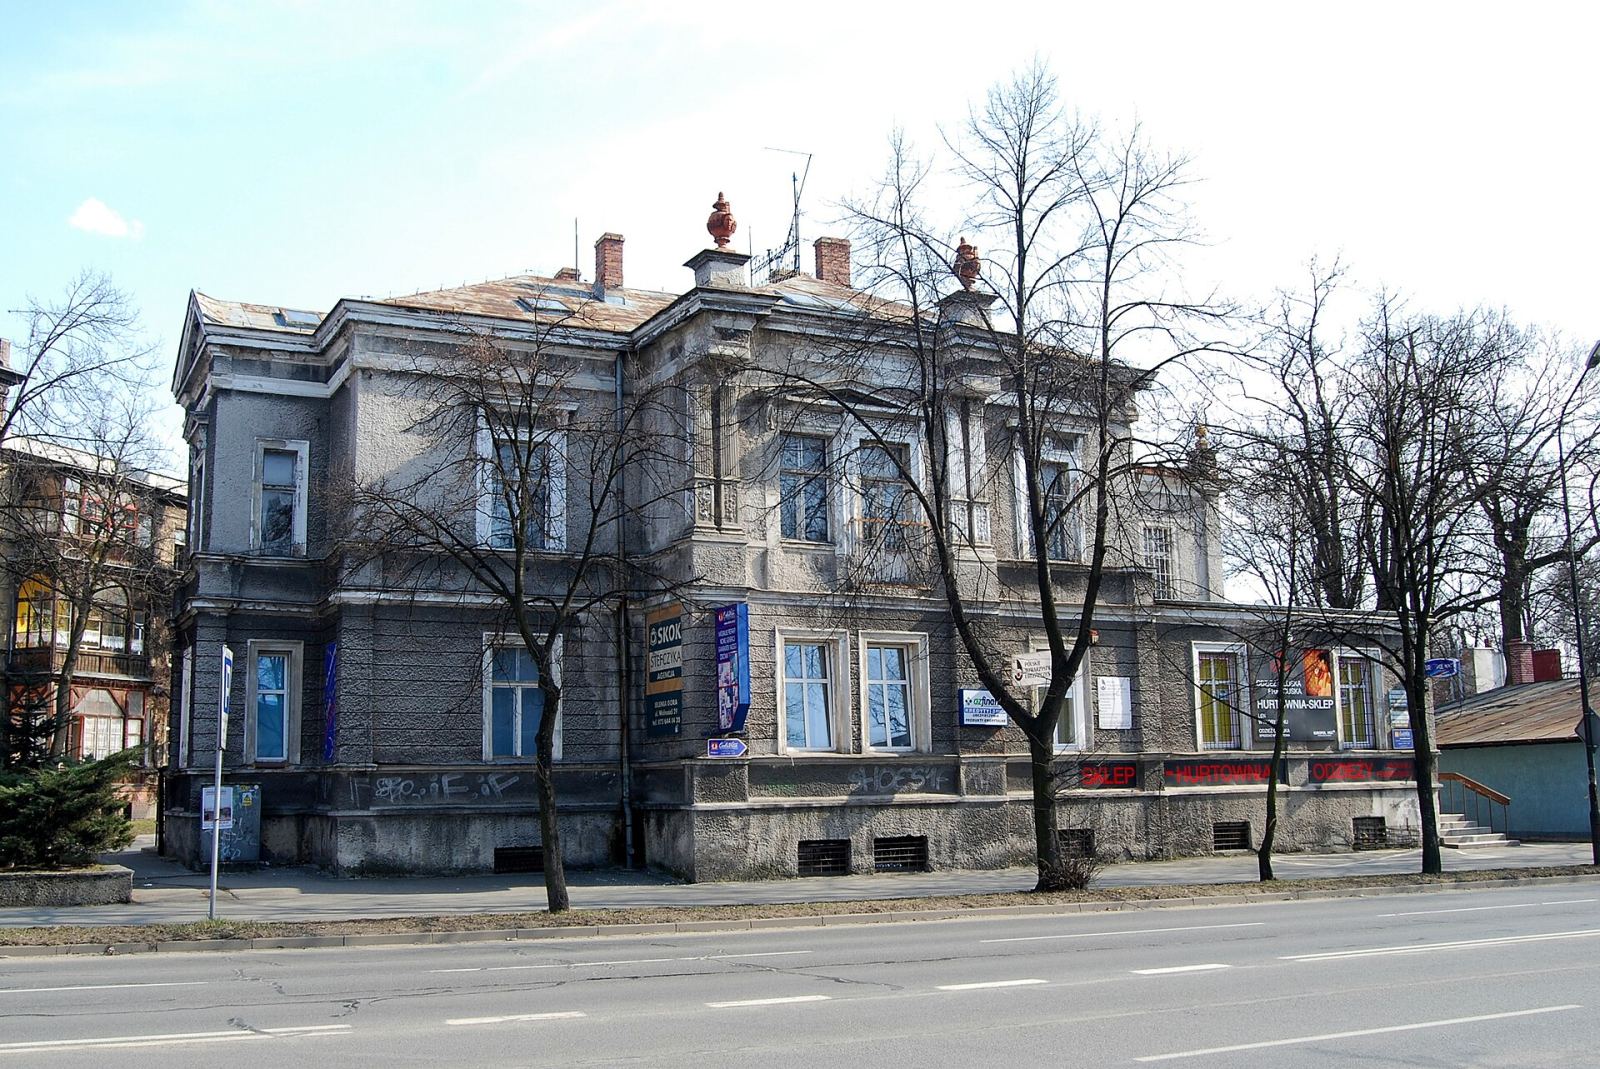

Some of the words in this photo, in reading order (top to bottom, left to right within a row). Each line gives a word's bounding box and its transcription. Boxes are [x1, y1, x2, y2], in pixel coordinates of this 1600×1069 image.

[658, 622, 682, 644] SKOK
[650, 650, 681, 668] STEFCZYKA
[656, 669, 675, 680] AGENCJA
[1257, 699, 1334, 710] HURTWNIA-SKLEP
[1082, 766, 1136, 785] SKLEP
[1312, 760, 1373, 781] ODZIEŻY
